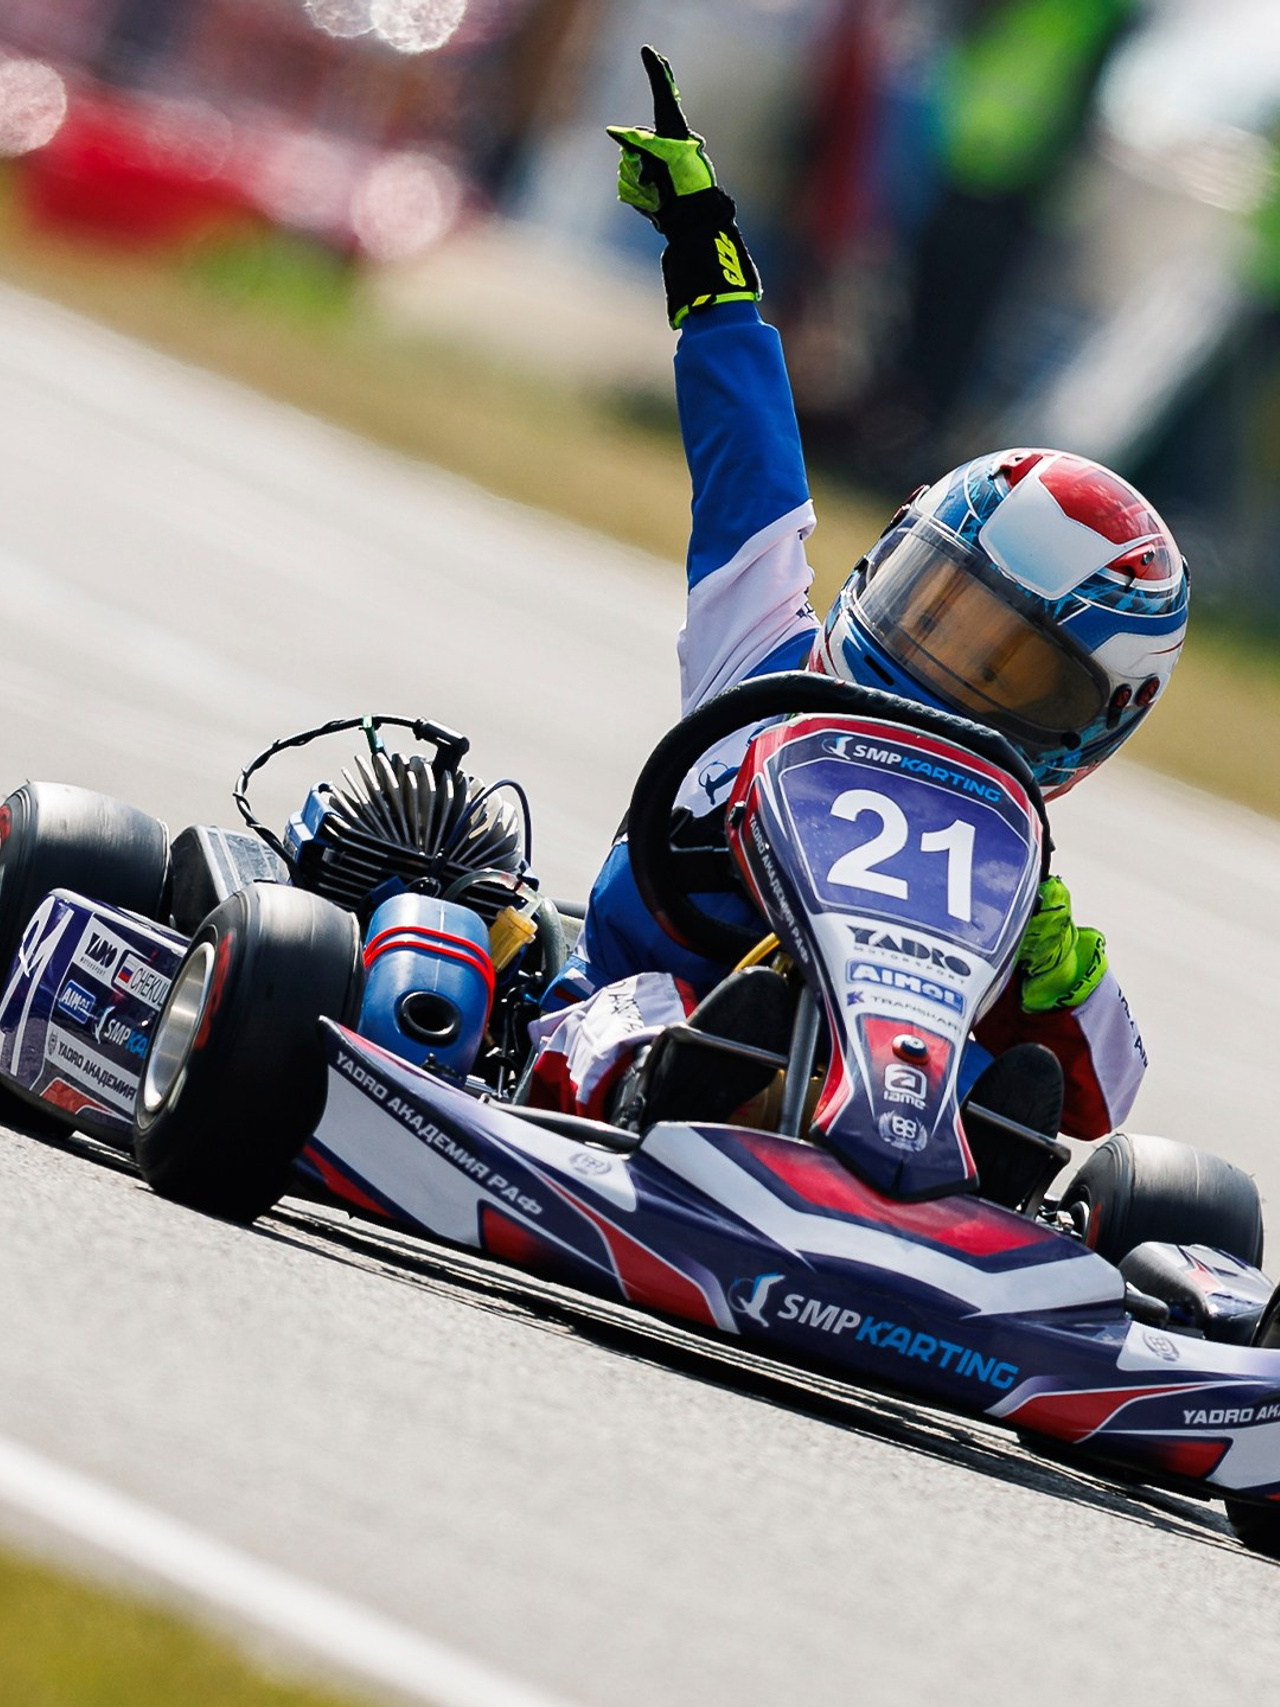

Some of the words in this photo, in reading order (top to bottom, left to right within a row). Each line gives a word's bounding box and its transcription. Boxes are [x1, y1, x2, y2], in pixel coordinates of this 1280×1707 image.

[826, 788, 976, 923] 21
[58, 1041, 85, 1069] YADRO
[336, 1050, 390, 1101] YADRO
[387, 1096, 490, 1181] АКАДЕМИЯ
[487, 1174, 544, 1216] РАФ
[1182, 1408, 1255, 1425] YADRO
